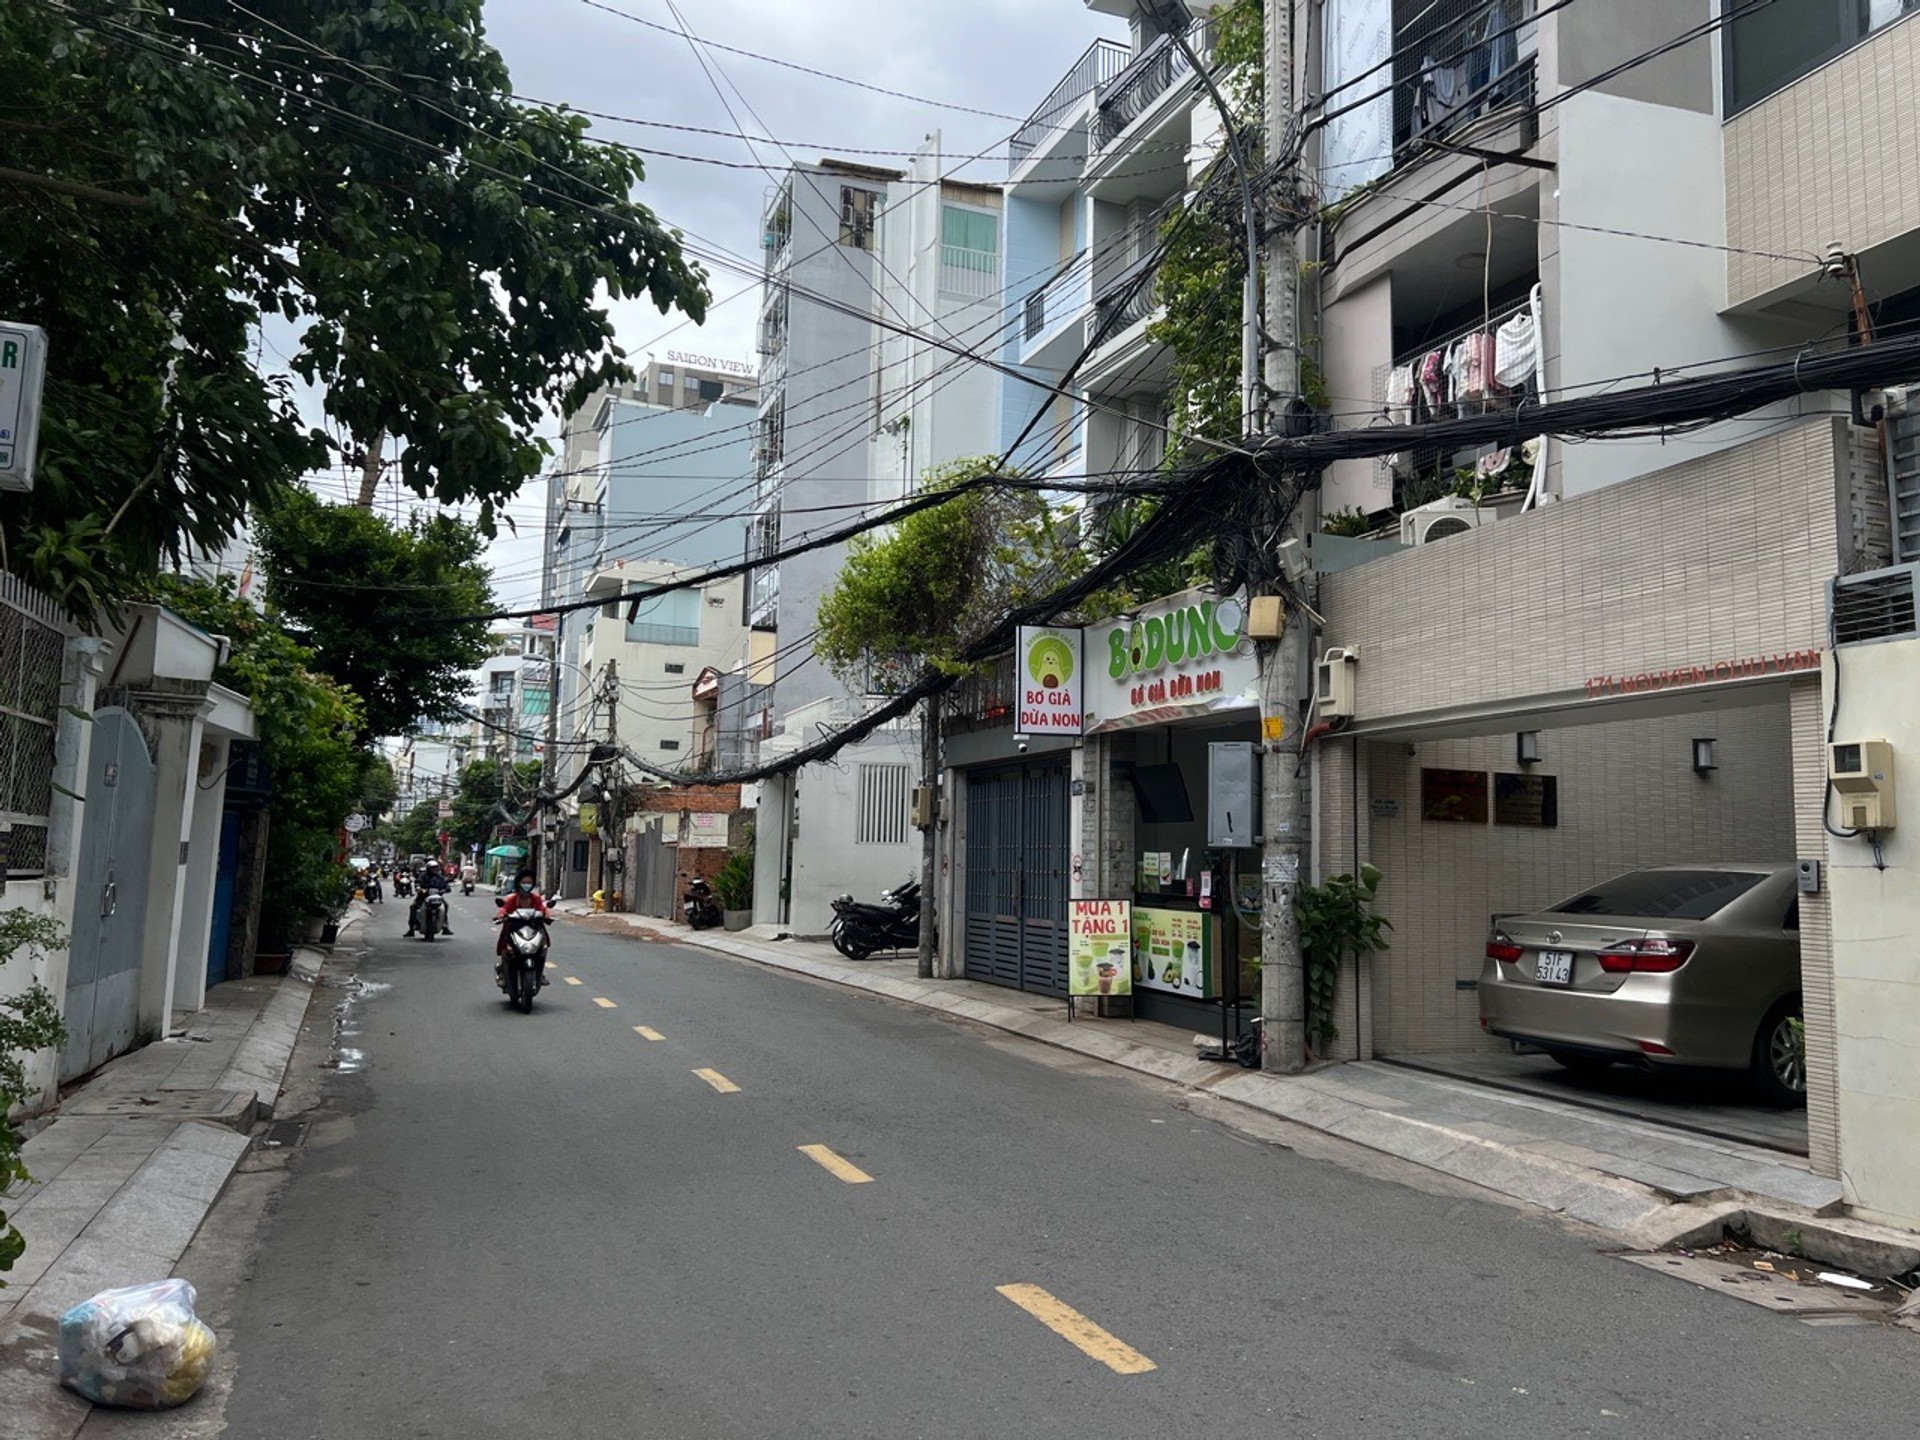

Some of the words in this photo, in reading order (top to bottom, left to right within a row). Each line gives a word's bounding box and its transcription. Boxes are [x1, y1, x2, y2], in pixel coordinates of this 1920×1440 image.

[667, 350, 717, 368] SAIGON
[719, 358, 755, 374] VIEW
[1196, 670, 1221, 693] NON
[1584, 675, 1613, 698] 171
[1026, 689, 1044, 705] BƠ
[1048, 688, 1071, 706] GIÀ
[1021, 707, 1048, 726] DỪA
[1051, 712, 1081, 728] NON
[1075, 900, 1112, 916] MUA
[1117, 901, 1124, 915] 1
[1121, 919, 1128, 933] 1
[1545, 952, 1564, 966] 51F
